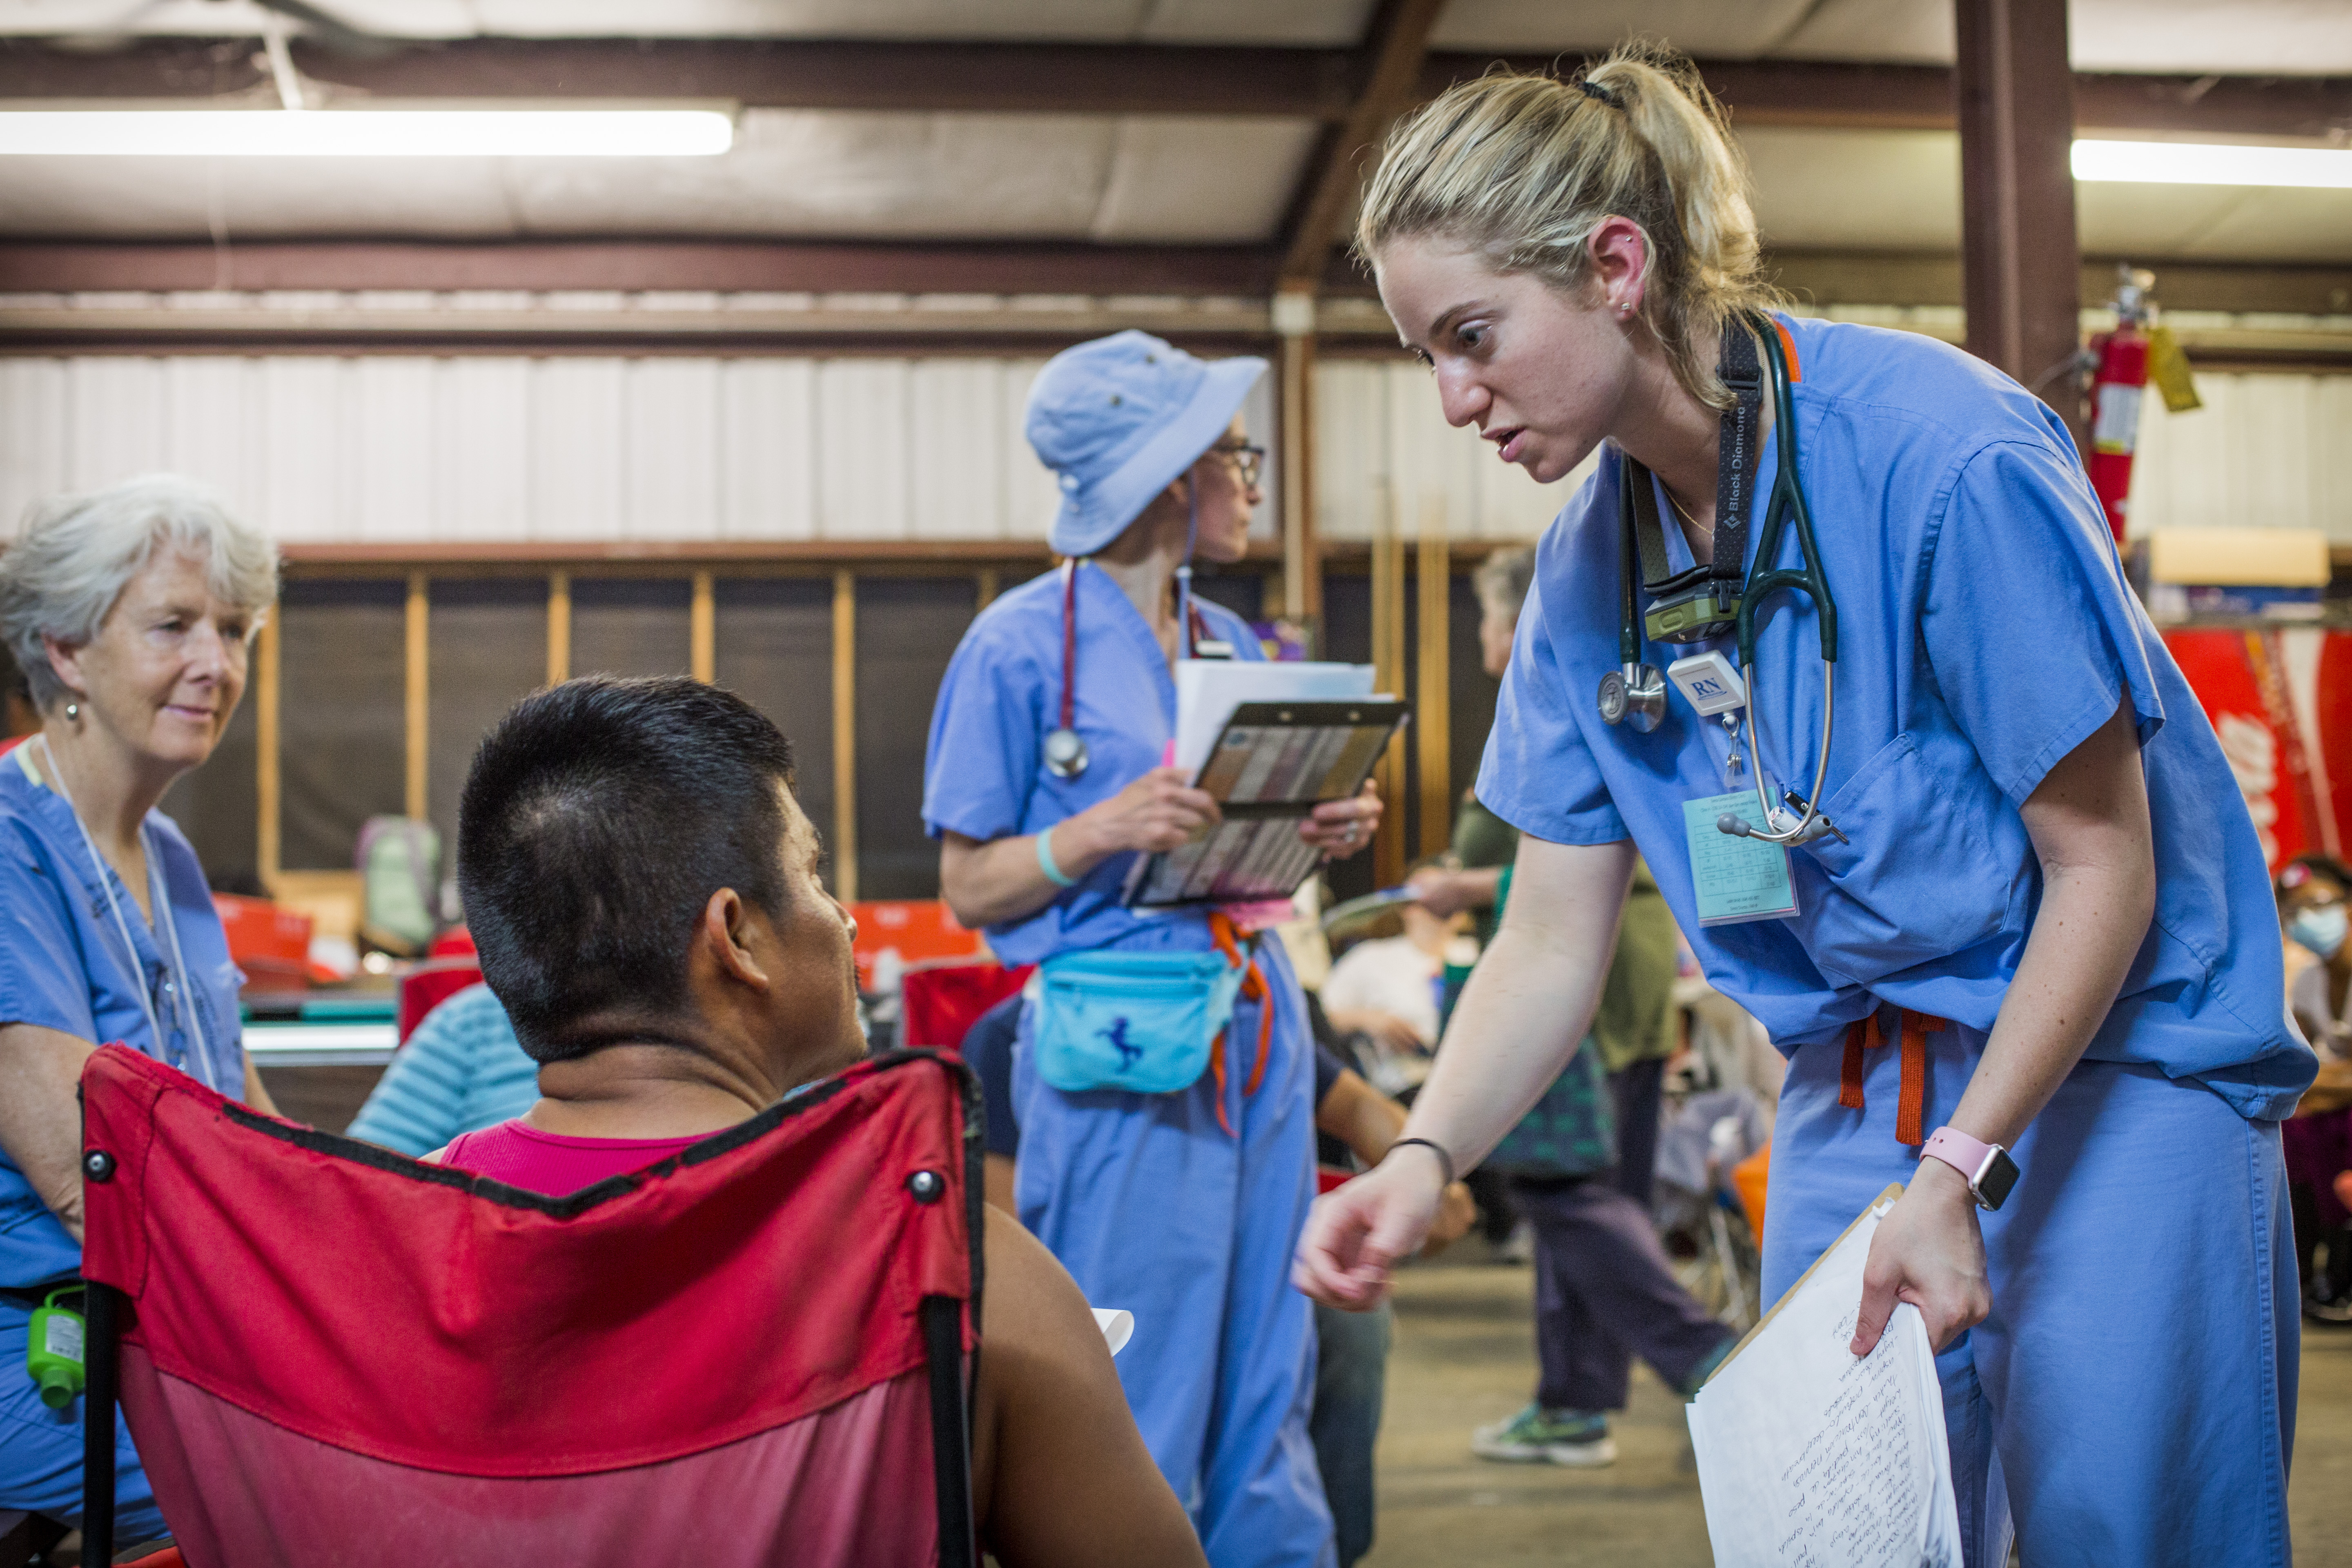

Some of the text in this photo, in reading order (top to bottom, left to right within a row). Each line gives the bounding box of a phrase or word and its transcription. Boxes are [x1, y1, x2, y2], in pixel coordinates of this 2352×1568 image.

[1729, 473, 1741, 511] Black
[1690, 677, 1721, 696] RN
[1855, 1362, 1873, 1381] down
[1810, 1480, 1820, 1494] de
[1788, 1492, 1806, 1518] peso
[1816, 1500, 1825, 1510] de
[1805, 1512, 1813, 1522] la
